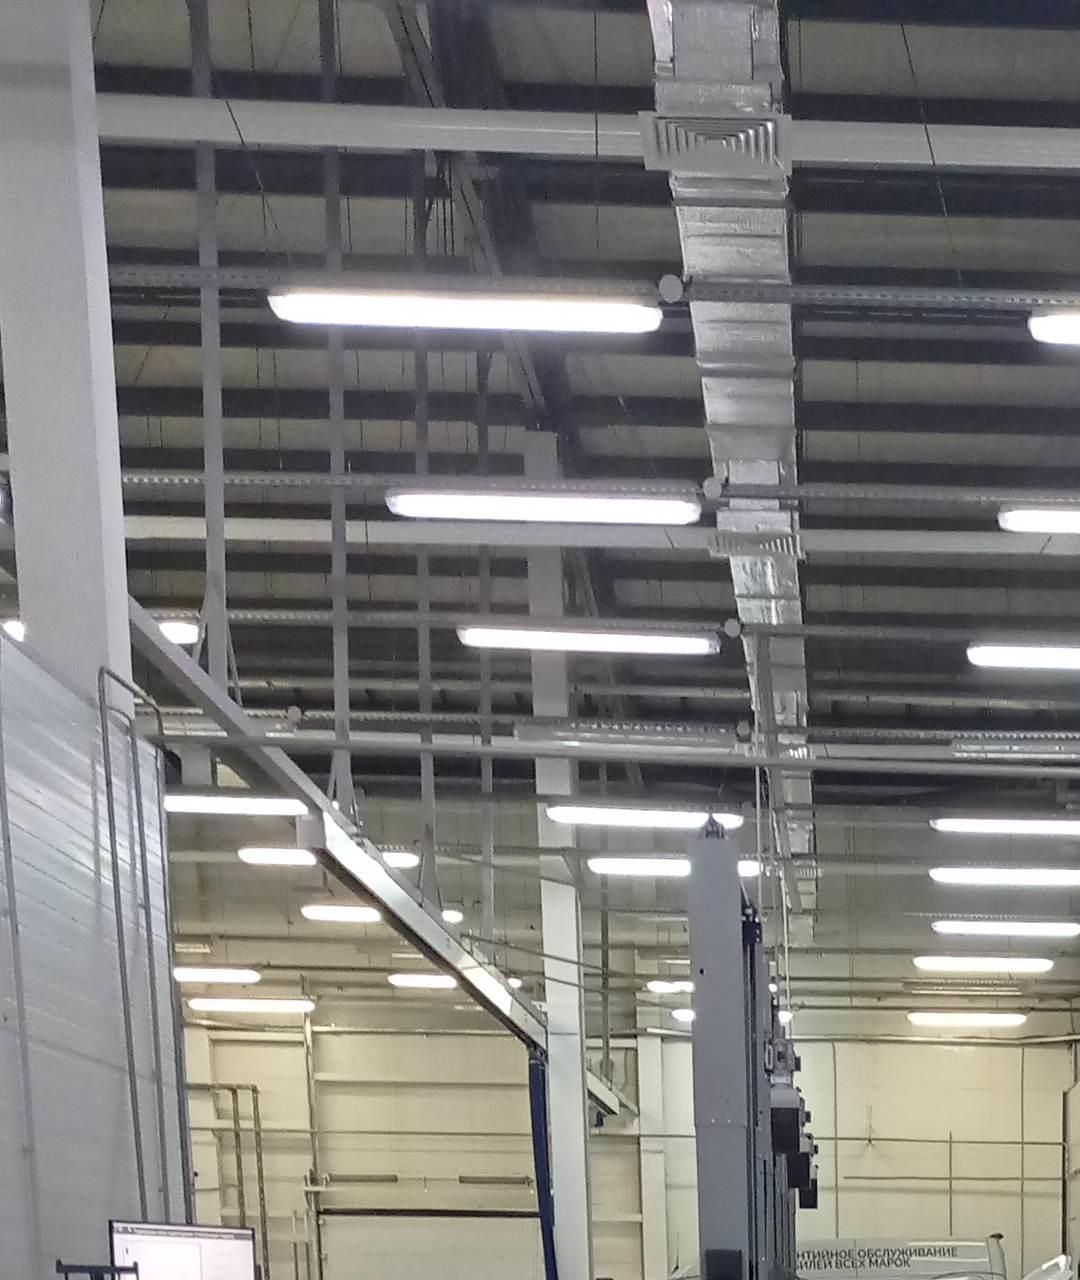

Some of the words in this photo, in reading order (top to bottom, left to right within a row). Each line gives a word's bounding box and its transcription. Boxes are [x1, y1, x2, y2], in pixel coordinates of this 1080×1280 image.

[857, 1247, 957, 1258] ОБСЛУЖИВАНИЕ
[835, 1259, 865, 1269] ВСЕХ
[869, 1257, 911, 1268] МАРОК
